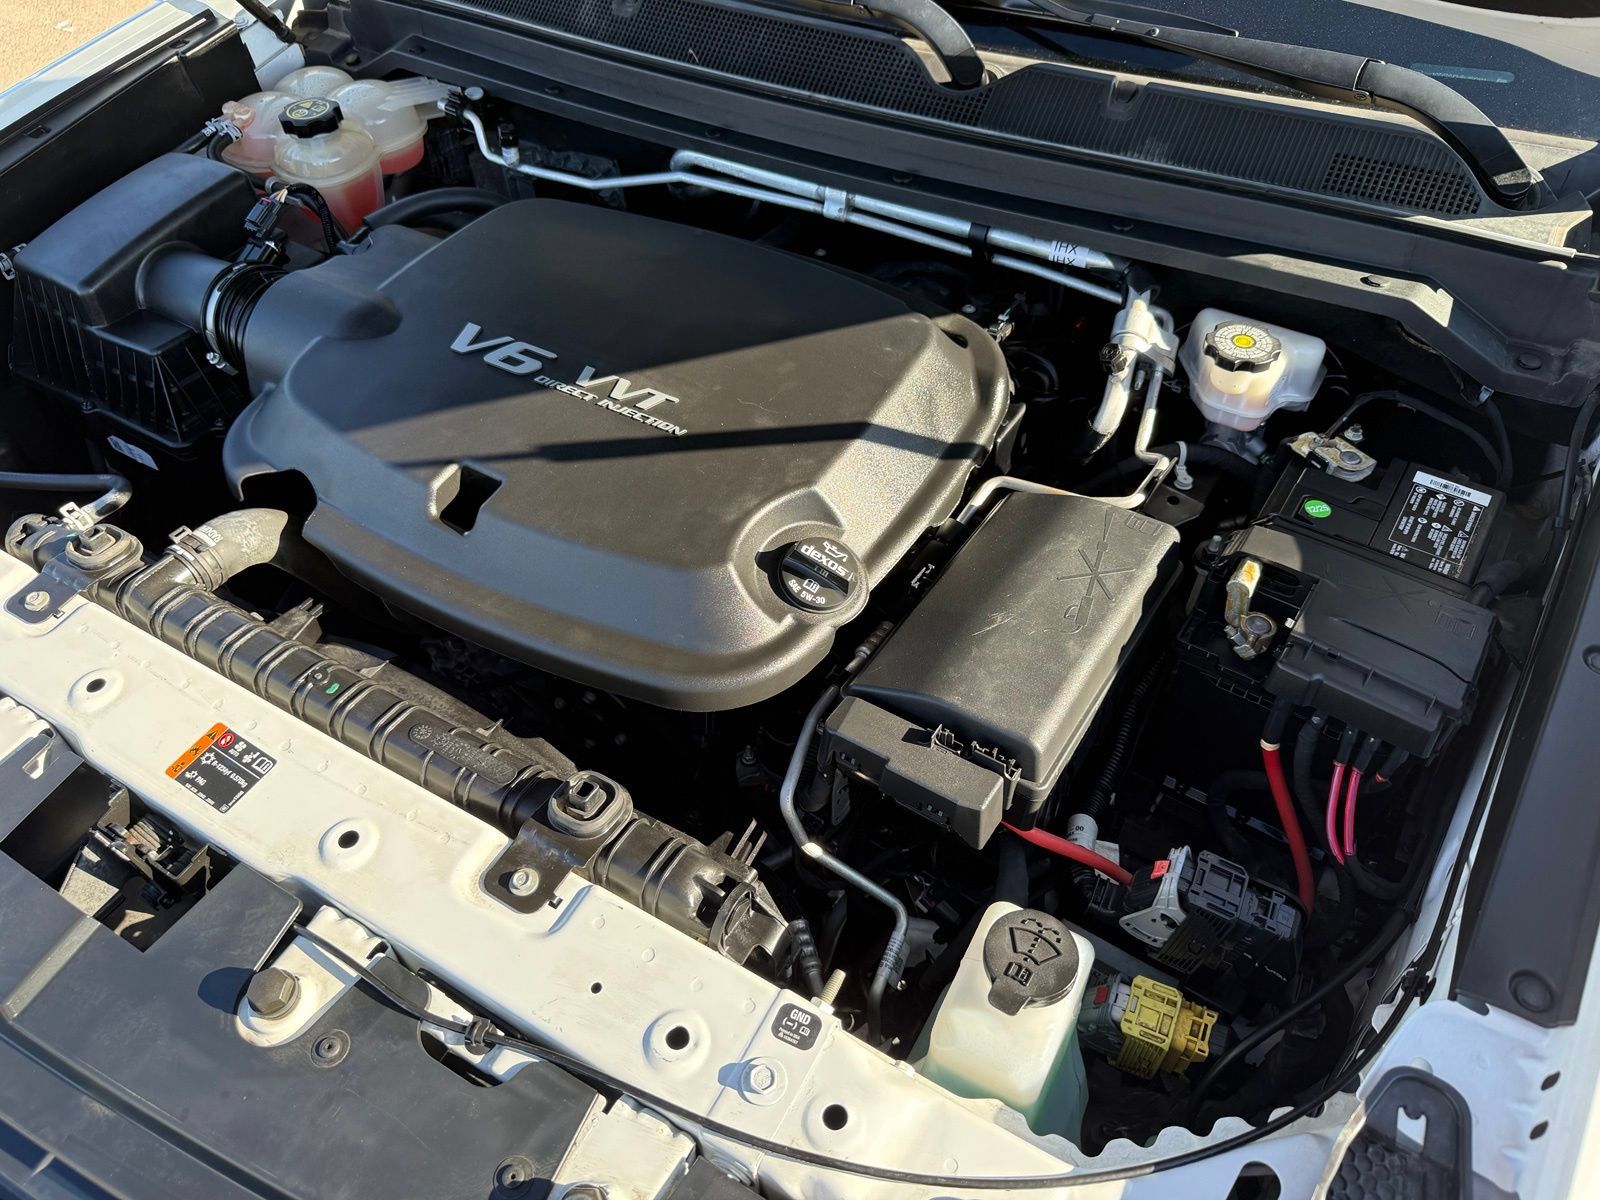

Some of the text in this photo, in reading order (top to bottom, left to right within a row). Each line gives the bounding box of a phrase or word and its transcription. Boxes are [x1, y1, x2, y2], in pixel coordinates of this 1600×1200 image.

[450, 322, 558, 376] V6
[533, 375, 688, 437] DIRECT INJECTION
[575, 365, 680, 411] VVT
[800, 544, 849, 577] dexos
[788, 579, 826, 605] SAE 5W-30
[790, 1008, 811, 1025] GND
